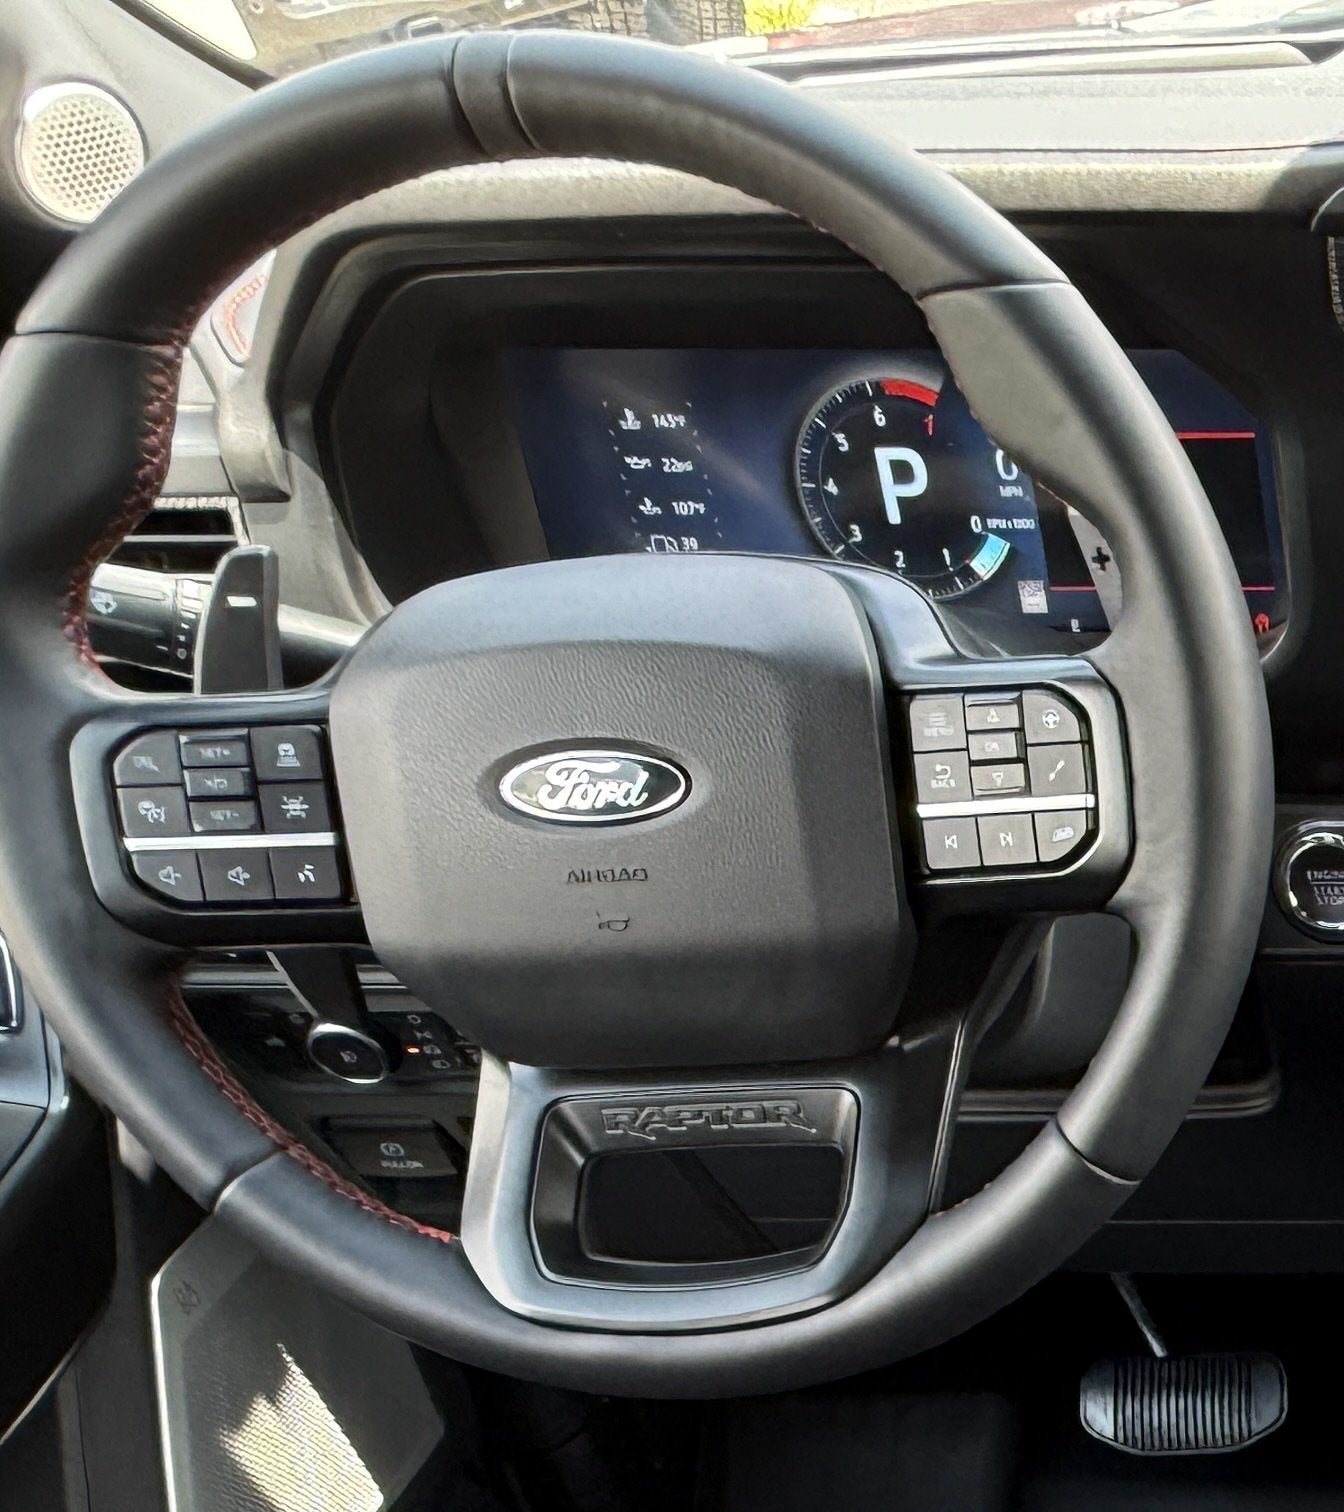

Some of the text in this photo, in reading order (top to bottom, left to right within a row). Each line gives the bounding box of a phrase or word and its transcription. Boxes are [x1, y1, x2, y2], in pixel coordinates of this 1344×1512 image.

[872, 405, 887, 427] 6
[832, 432, 850, 453] 5
[823, 476, 840, 497] 4
[873, 446, 928, 525] P
[848, 523, 863, 544] 3
[970, 515, 982, 533] 0
[893, 550, 906, 569] 2
[537, 759, 650, 811] Ford
[601, 1101, 817, 1141] RAPTOR
